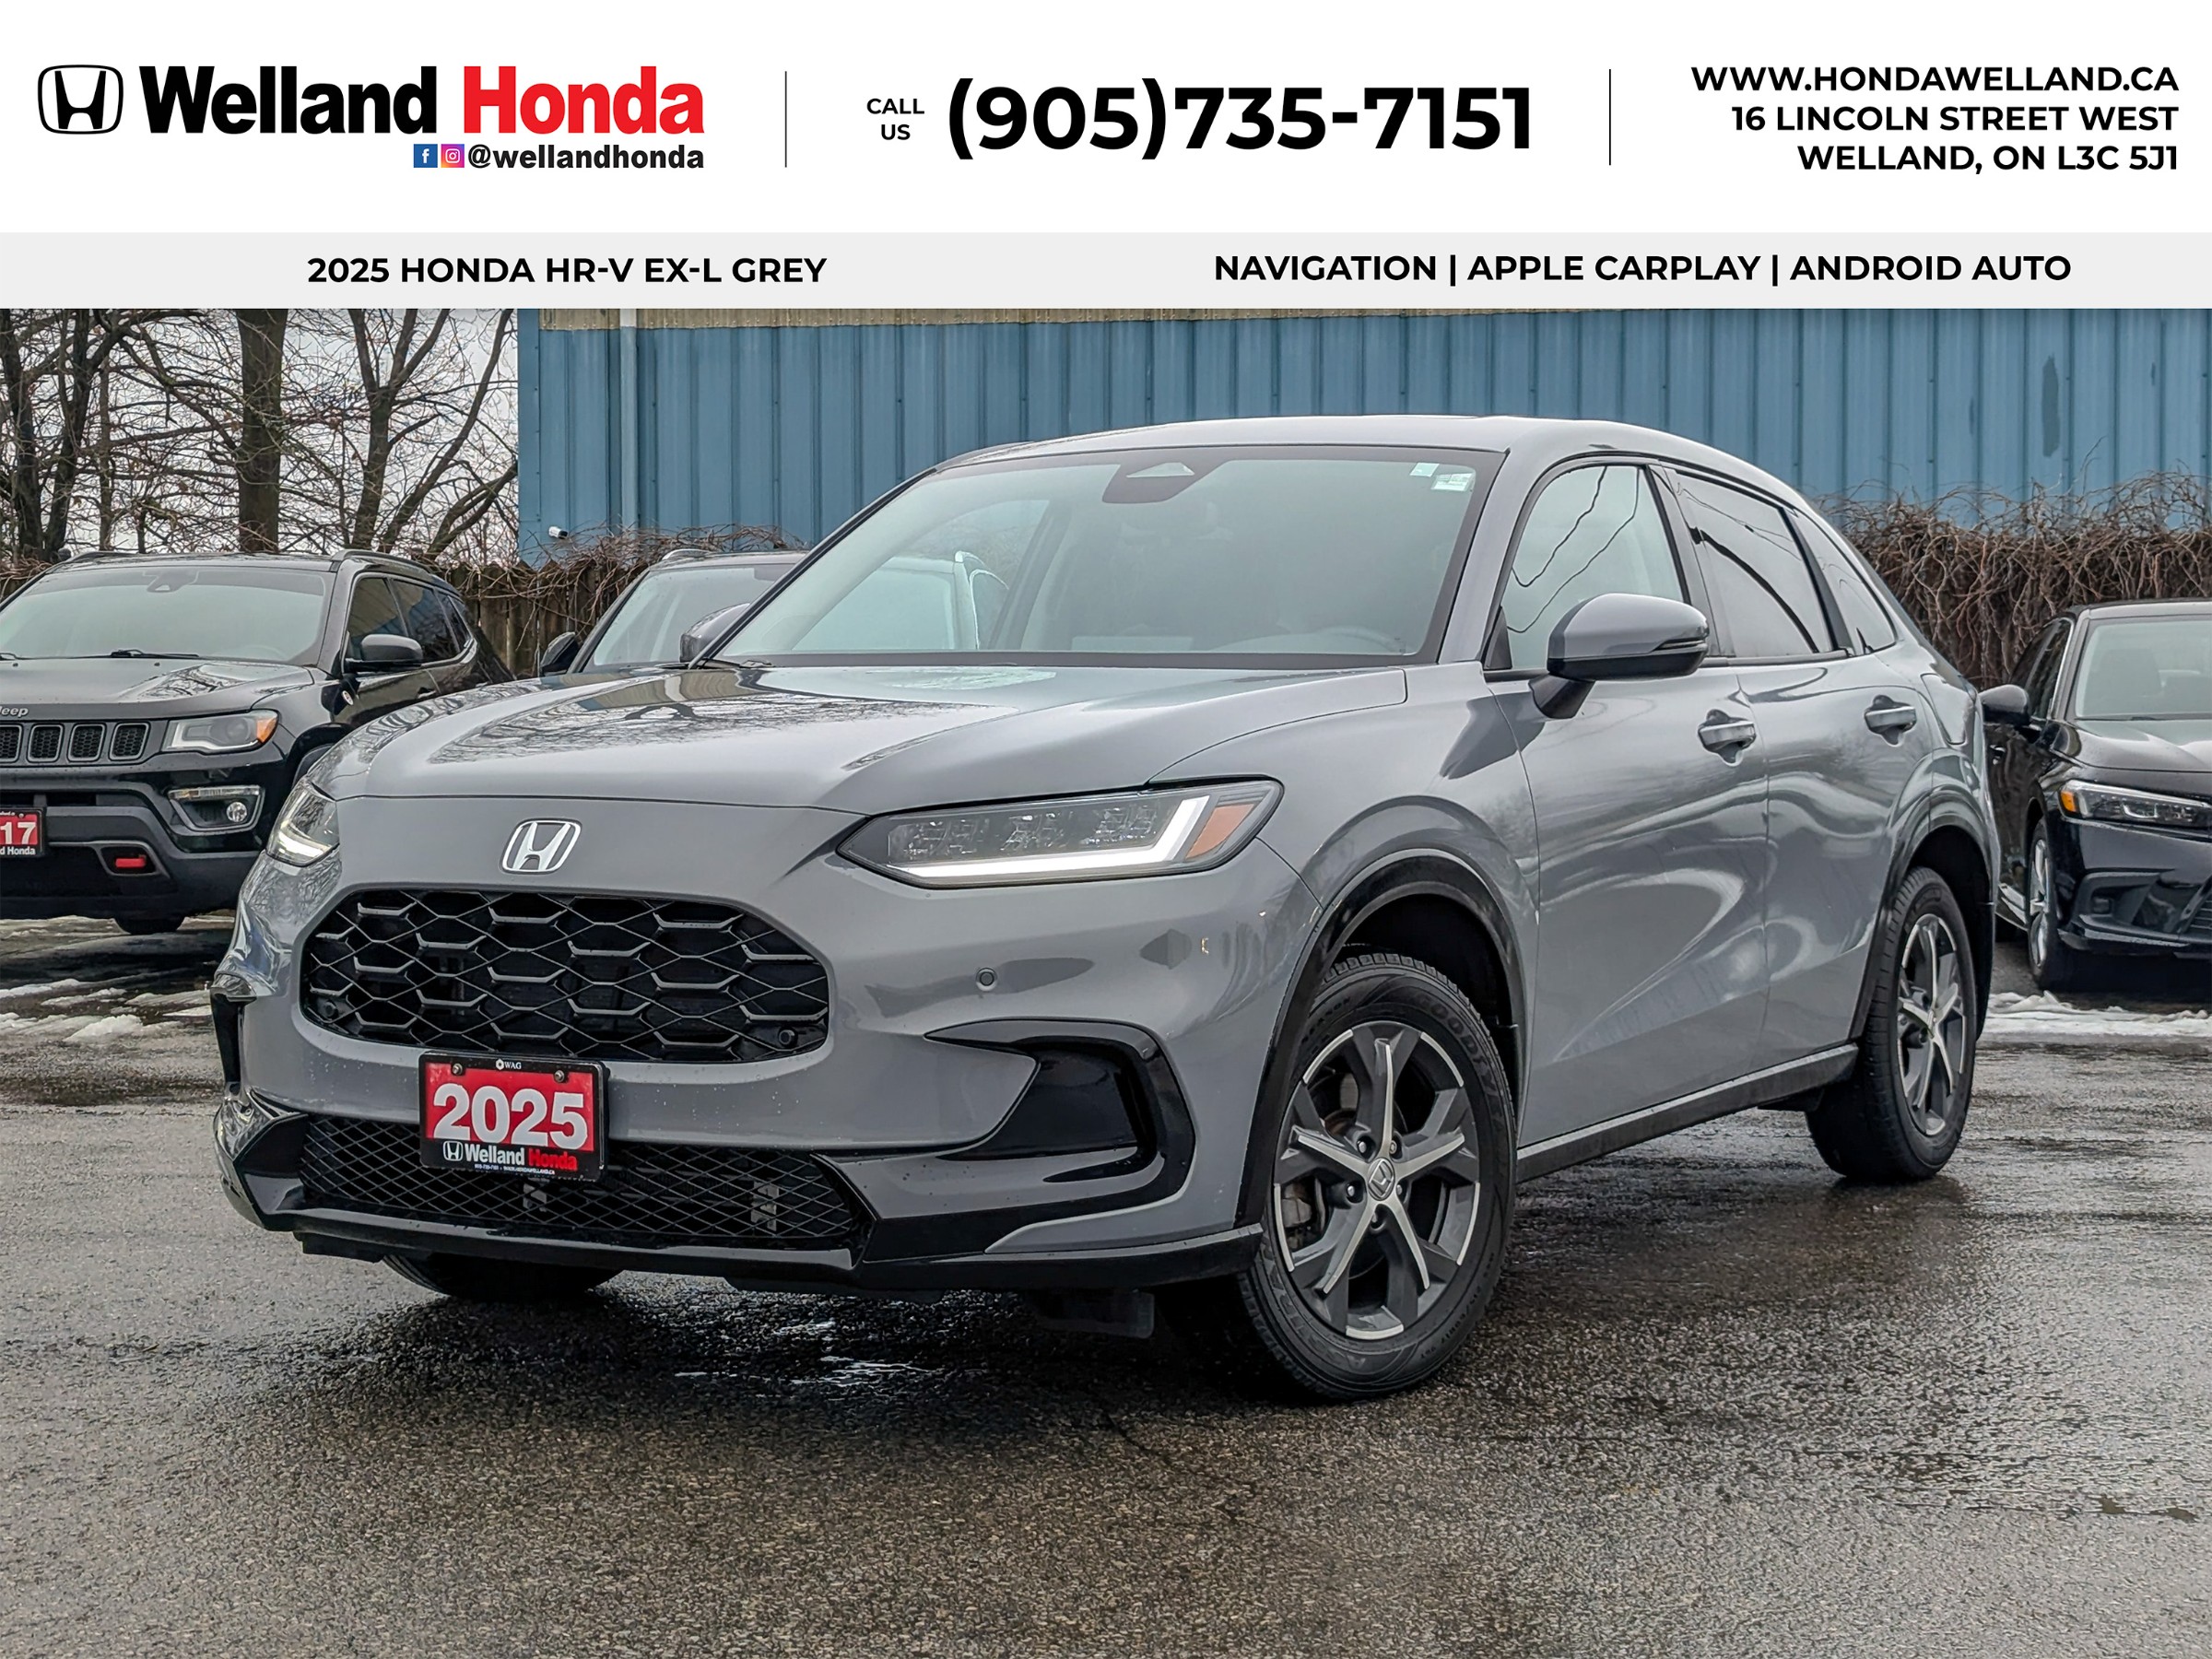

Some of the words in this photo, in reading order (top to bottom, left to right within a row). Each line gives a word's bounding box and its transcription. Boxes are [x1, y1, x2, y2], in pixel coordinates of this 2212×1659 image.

[7, 846, 36, 855] Honda
[504, 1061, 522, 1070] WAG
[433, 1082, 588, 1150] 2025
[465, 1143, 525, 1166] Welland
[528, 1147, 578, 1171] Honda
